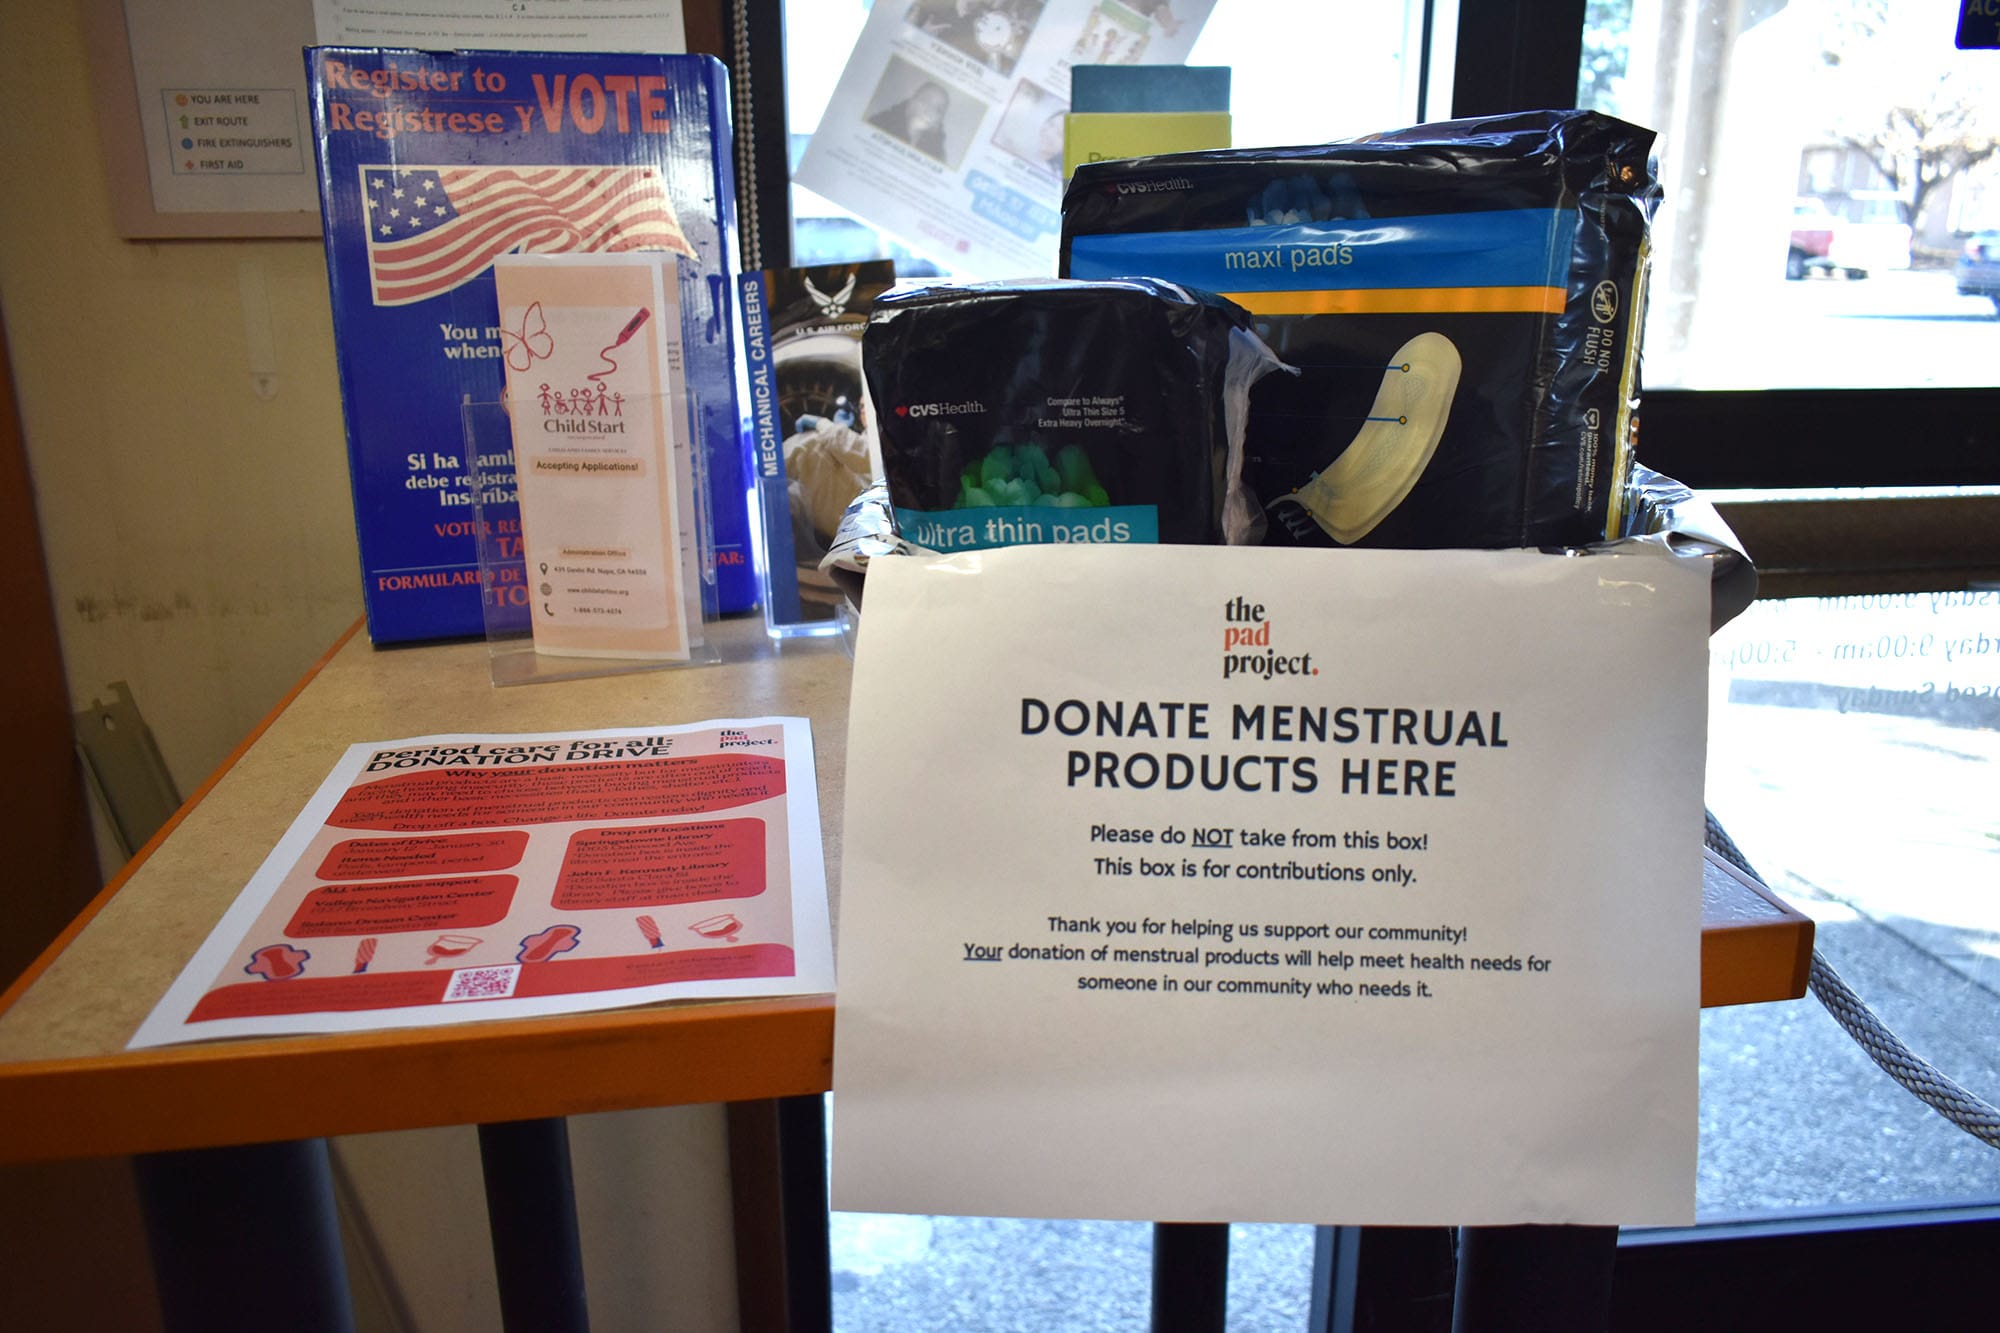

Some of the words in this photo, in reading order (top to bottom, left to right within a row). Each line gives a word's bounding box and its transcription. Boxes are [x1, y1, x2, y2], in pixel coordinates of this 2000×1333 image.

[325, 60, 463, 98] Register
[472, 67, 506, 93] to
[190, 94, 211, 104] YOU
[214, 94, 232, 104] ARE
[234, 94, 260, 104] HERE
[532, 73, 670, 134] VOTE
[194, 116, 213, 126] EXIT
[217, 116, 248, 126] ROUTE
[197, 138, 217, 148] FIRE
[219, 138, 293, 148] EXTINGUISHERS
[200, 160, 224, 169] FIRST
[227, 160, 244, 169] AID
[1224, 243, 1282, 271] maxi
[1290, 242, 1353, 272] pads
[745, 280, 767, 361] CAREERS
[440, 324, 478, 341] You
[818, 325, 835, 334] AIR
[1601, 329, 1614, 347] DO
[444, 343, 503, 360] when
[1583, 326, 1600, 365] FLUSH
[1597, 350, 1611, 374] NOT
[1047, 397, 1081, 406] Compare
[1082, 397, 1091, 405] to
[754, 364, 778, 477] MECHANICAL
[1062, 408, 1081, 417] Ultra
[1101, 408, 1117, 416] Size
[543, 419, 586, 433] Child
[588, 419, 625, 434] Start
[1038, 418, 1058, 428] Extra
[1059, 419, 1082, 429] Heavy
[407, 453, 426, 470] Si
[433, 453, 460, 469] ha
[536, 460, 579, 472] Accepting
[582, 461, 638, 473] Applications!
[405, 474, 450, 489] debe
[498, 519, 521, 534] RE
[917, 521, 976, 547] ultra
[986, 517, 1042, 543] thin
[1052, 517, 1131, 544] pads
[501, 568, 522, 583] DE
[1224, 596, 1265, 623] the
[1224, 621, 1270, 651] pad
[1223, 649, 1319, 680] project.
[1021, 698, 1209, 739] DONATE
[1232, 704, 1508, 748] MENSTRUAL
[720, 729, 746, 737] the
[720, 734, 748, 742] pad
[373, 744, 480, 762] Period
[489, 744, 560, 755] care
[569, 740, 618, 751] for
[625, 735, 673, 748] all:
[720, 738, 779, 749] project.
[366, 752, 556, 772] DONATION
[565, 746, 670, 761] DRIVE
[445, 769, 488, 778] Why
[492, 769, 535, 778] your
[538, 763, 621, 774] donation
[625, 758, 698, 768] matters
[1067, 750, 1318, 793] PRODUCTS
[1342, 758, 1456, 797] HERE
[600, 829, 636, 837] Drop
[661, 823, 725, 832] locations
[667, 833, 713, 841] Library
[1090, 823, 1155, 844] Please
[1159, 824, 1187, 845] do
[1191, 827, 1235, 849] NOT
[1239, 827, 1287, 848] take
[1291, 827, 1337, 849] from
[1342, 829, 1380, 850] this
[1386, 830, 1428, 851] box!
[681, 861, 729, 870] Library
[1093, 856, 1133, 876] This
[1139, 856, 1176, 878] box
[1181, 857, 1198, 878] is
[1202, 858, 1232, 879] for
[1235, 860, 1366, 882] contributions
[1371, 863, 1417, 888] only.
[446, 890, 495, 899] Center
[1047, 915, 1102, 934] Thank
[1105, 920, 1137, 938] you
[1141, 916, 1167, 935] for
[1170, 918, 1235, 944] helping
[1238, 924, 1259, 937] us
[1263, 923, 1331, 942] support
[1334, 926, 1365, 940] our
[1367, 924, 1468, 946] community!
[962, 942, 1004, 963] Your
[1007, 942, 1086, 961] donation
[1090, 944, 1109, 962] of
[1113, 946, 1199, 964] menstrual
[1204, 948, 1280, 968] products
[1284, 949, 1312, 967] will
[1317, 950, 1355, 972] help
[1359, 953, 1405, 969] meet
[1410, 952, 1465, 970] health
[1470, 954, 1523, 972] needs
[1526, 954, 1552, 972] for
[1077, 976, 1158, 992] someone
[1162, 974, 1179, 992] in
[1183, 979, 1213, 993] our
[1216, 977, 1313, 999] community
[1316, 978, 1354, 996] who
[1358, 979, 1412, 998] needs
[1416, 980, 1433, 998] it.
